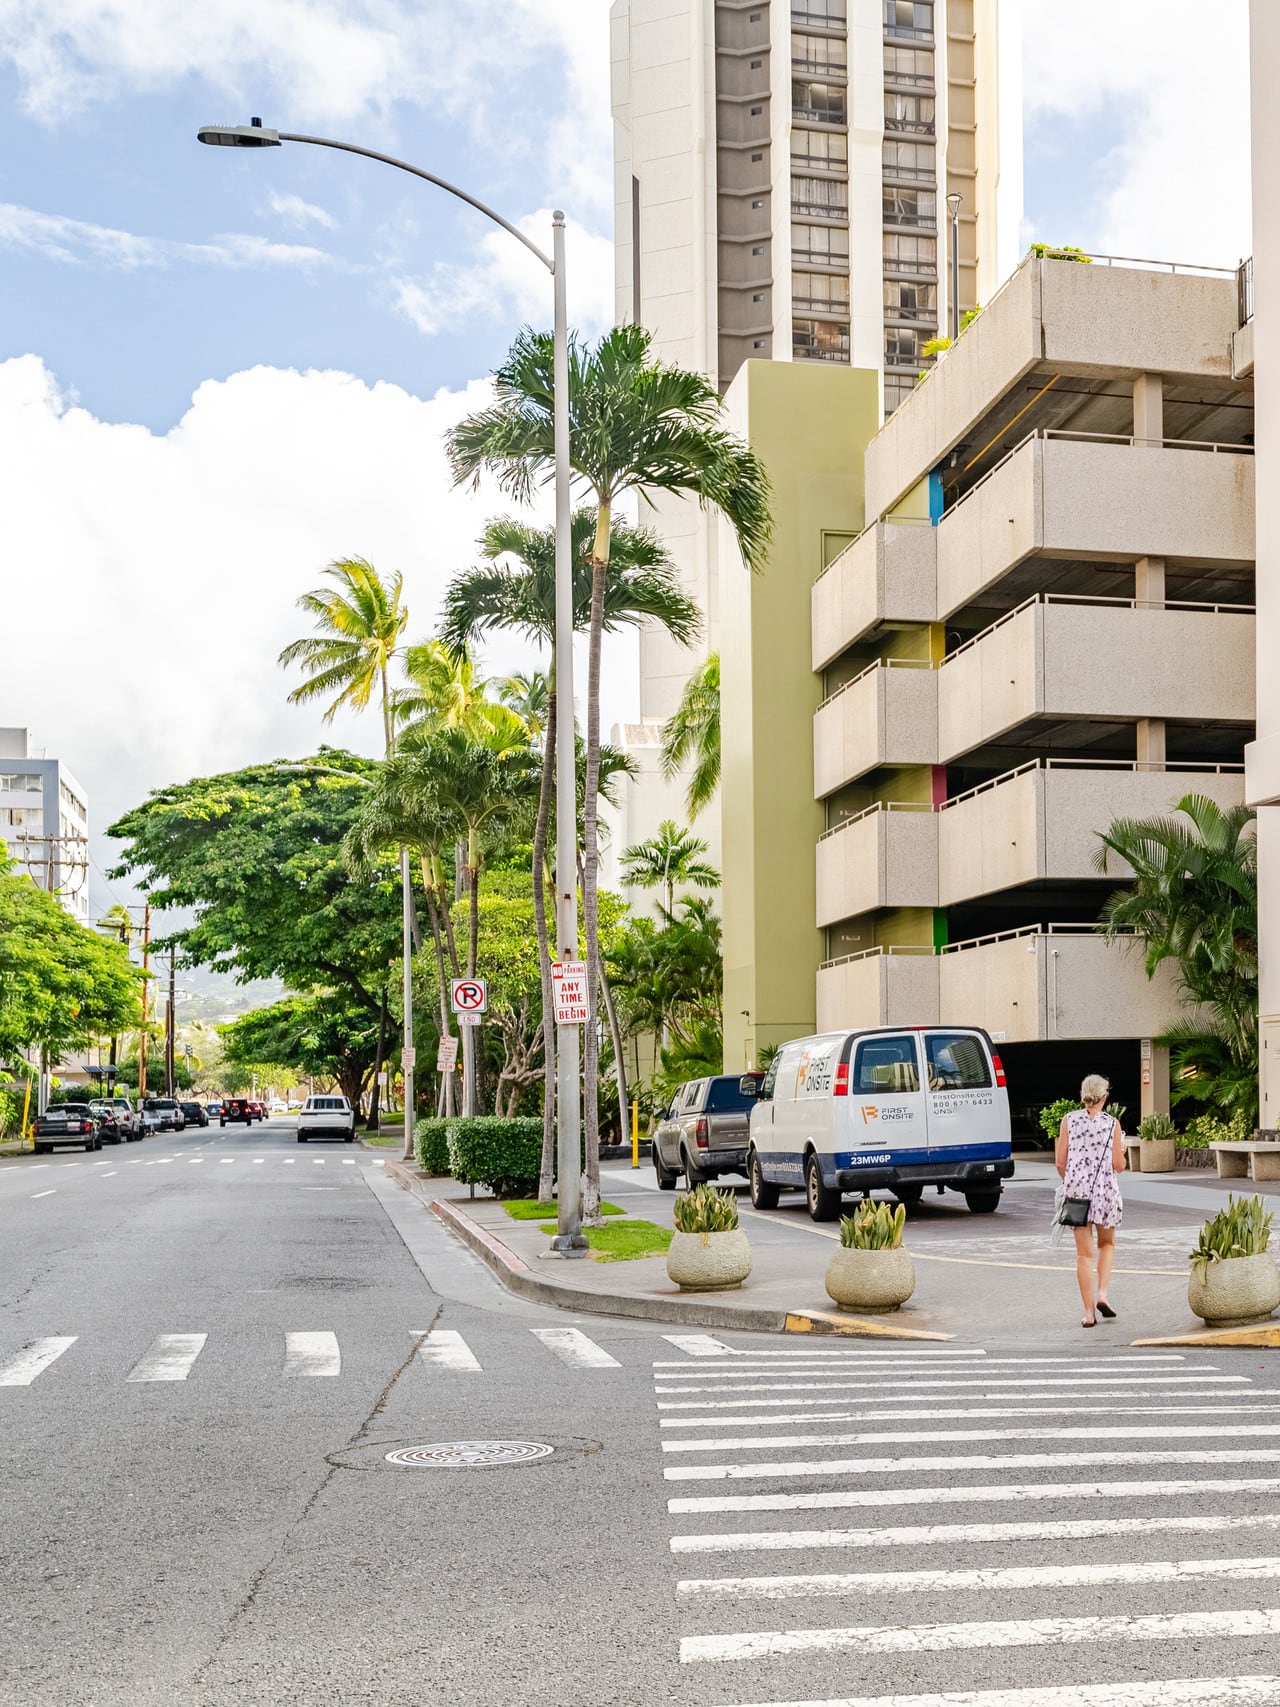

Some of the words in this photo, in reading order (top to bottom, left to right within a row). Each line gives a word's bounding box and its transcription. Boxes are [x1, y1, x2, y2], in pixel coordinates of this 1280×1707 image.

[564, 966, 585, 974] PARKING
[561, 982, 580, 992] ANY
[560, 993, 583, 1003] TIME
[558, 1009, 587, 1020] BEGIN
[808, 1056, 831, 1073] FIRST
[806, 1074, 831, 1092] ONSITE
[932, 1091, 993, 1100] FirstOnsite.com
[933, 1098, 993, 1108] 800.6226433
[881, 1106, 909, 1114] FIRST
[881, 1112, 915, 1121] ONSITE
[850, 1154, 892, 1166] 23MW6P
